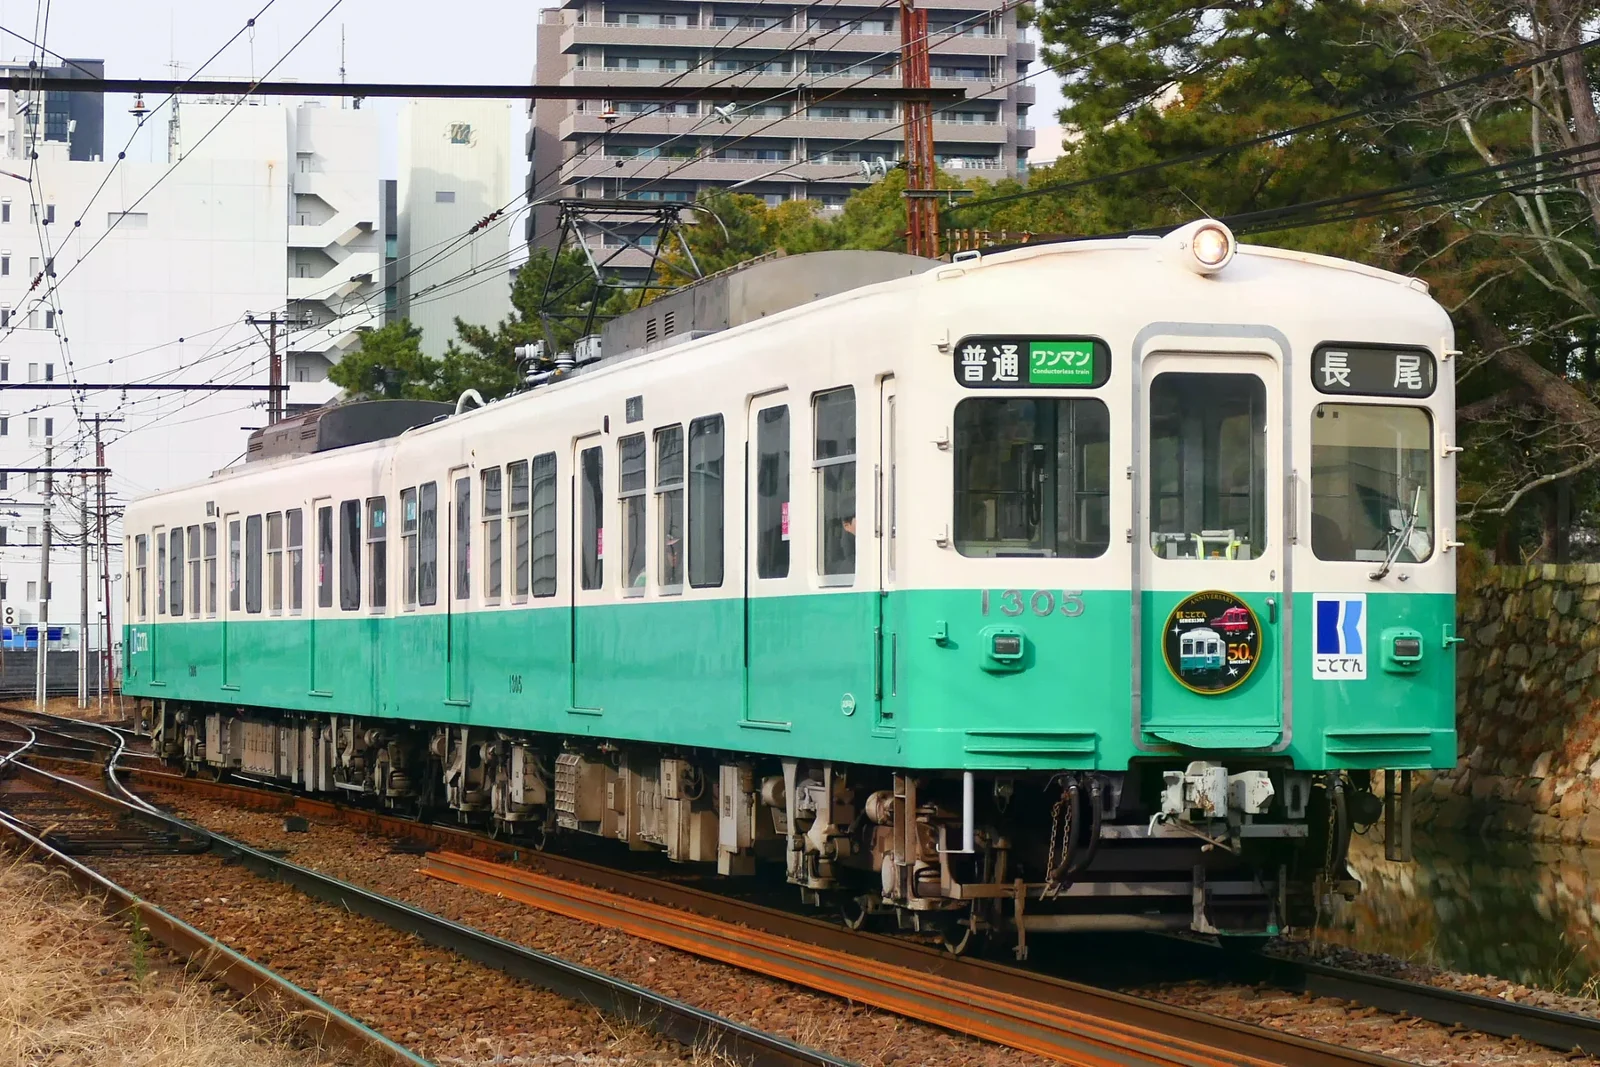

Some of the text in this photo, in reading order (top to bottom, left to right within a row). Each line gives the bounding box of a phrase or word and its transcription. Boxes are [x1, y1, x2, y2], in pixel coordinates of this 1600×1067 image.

[961, 344, 1019, 381] 普通
[1032, 350, 1090, 366] ワンマン
[1320, 352, 1422, 389] 長尾
[981, 588, 1085, 617] 1305
[1317, 658, 1363, 672] ことでん
